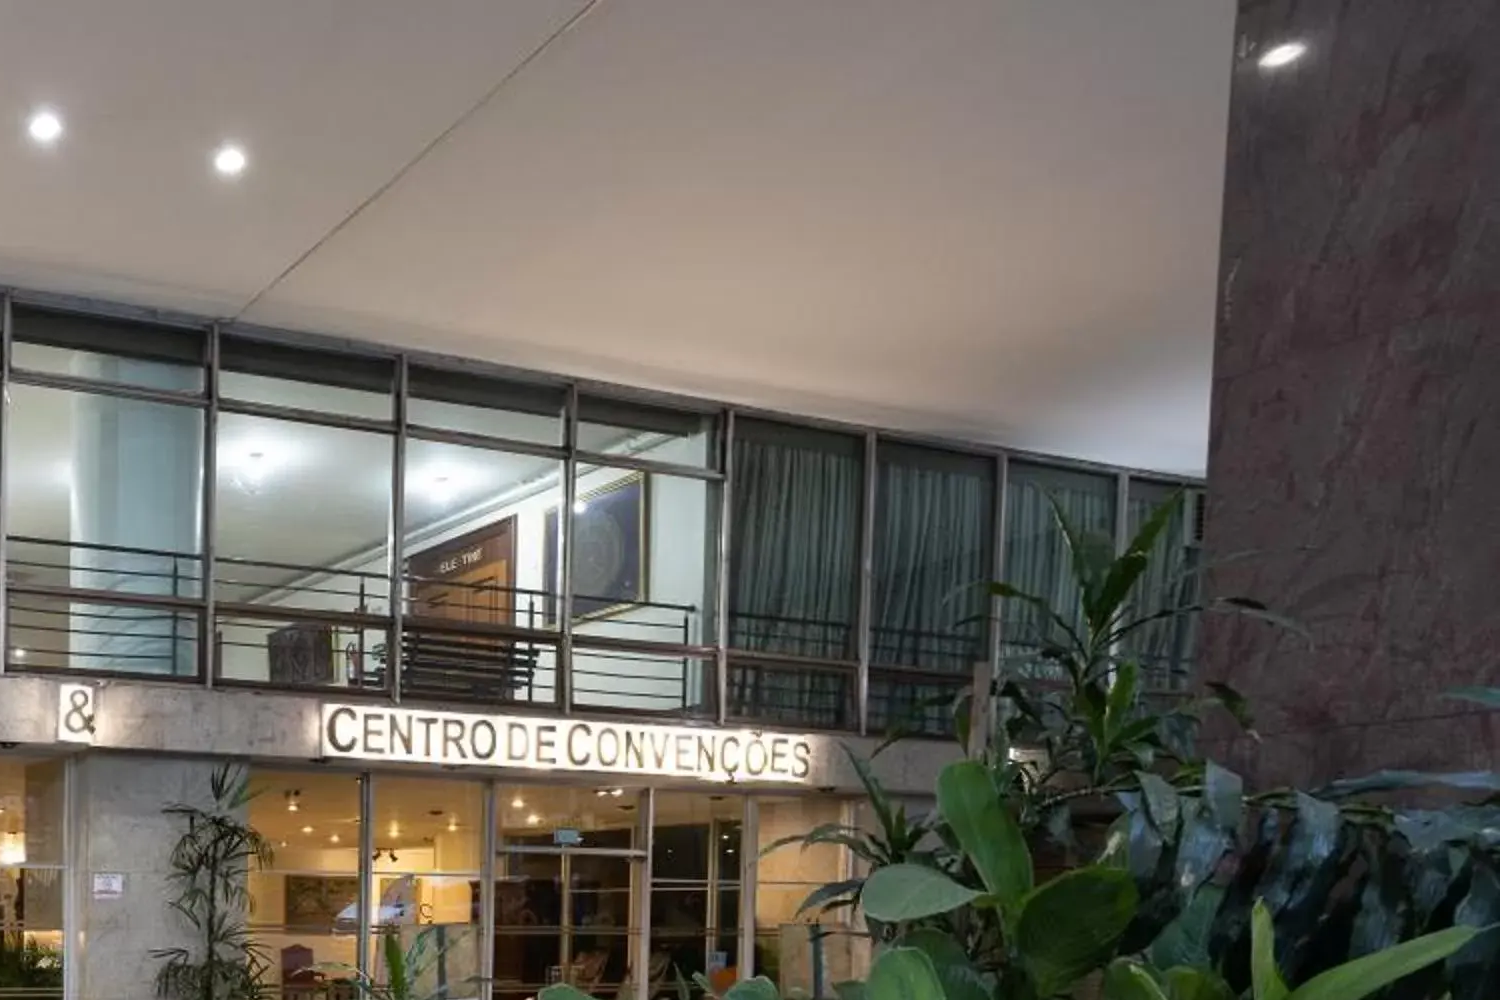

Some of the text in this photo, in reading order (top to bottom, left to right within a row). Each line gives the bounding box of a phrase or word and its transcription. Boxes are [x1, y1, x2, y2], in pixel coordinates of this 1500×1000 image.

[64, 690, 96, 735] &
[327, 707, 811, 785] CENTRO DE CONVENÇÕES
